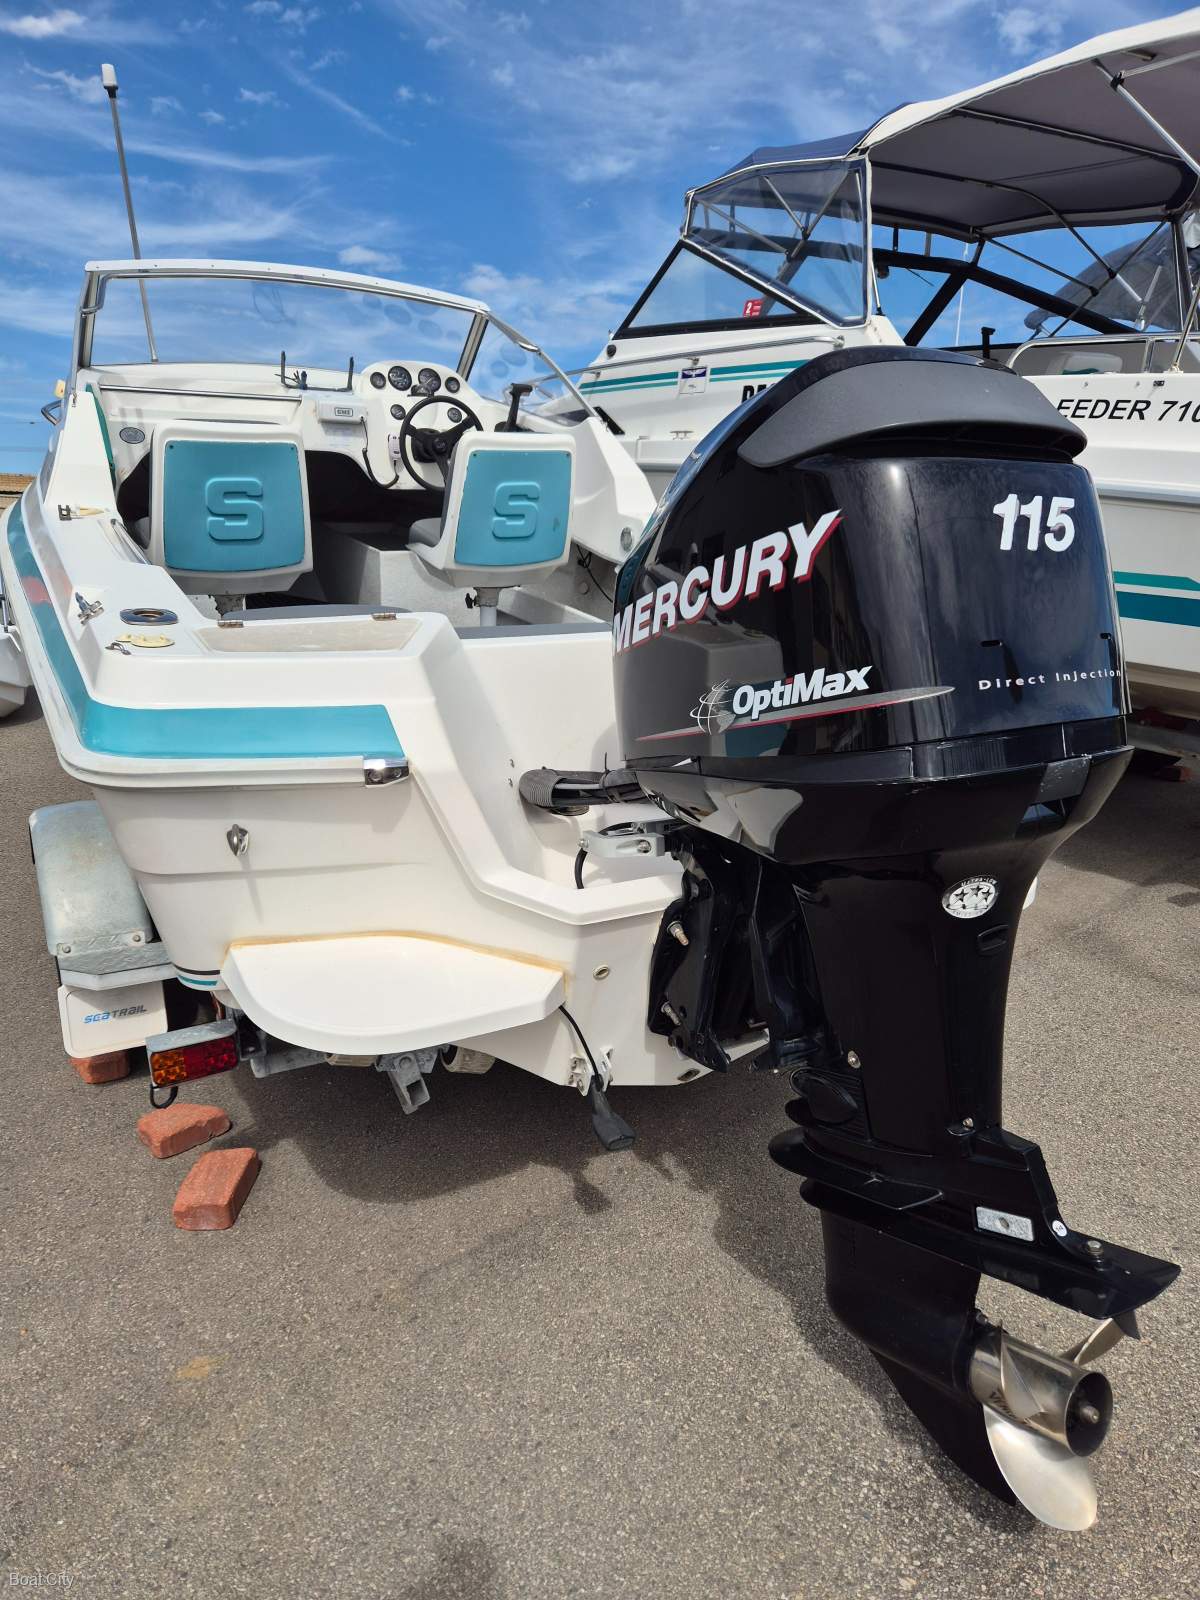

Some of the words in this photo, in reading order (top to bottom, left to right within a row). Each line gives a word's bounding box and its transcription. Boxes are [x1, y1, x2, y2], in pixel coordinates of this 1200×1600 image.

[205, 476, 264, 544] S
[492, 481, 540, 541] S
[992, 493, 1076, 552] 115
[612, 508, 845, 656] MERCURY
[732, 665, 873, 720] OptiMax
[978, 674, 1046, 690] Direct
[1055, 668, 1122, 682] Injection
